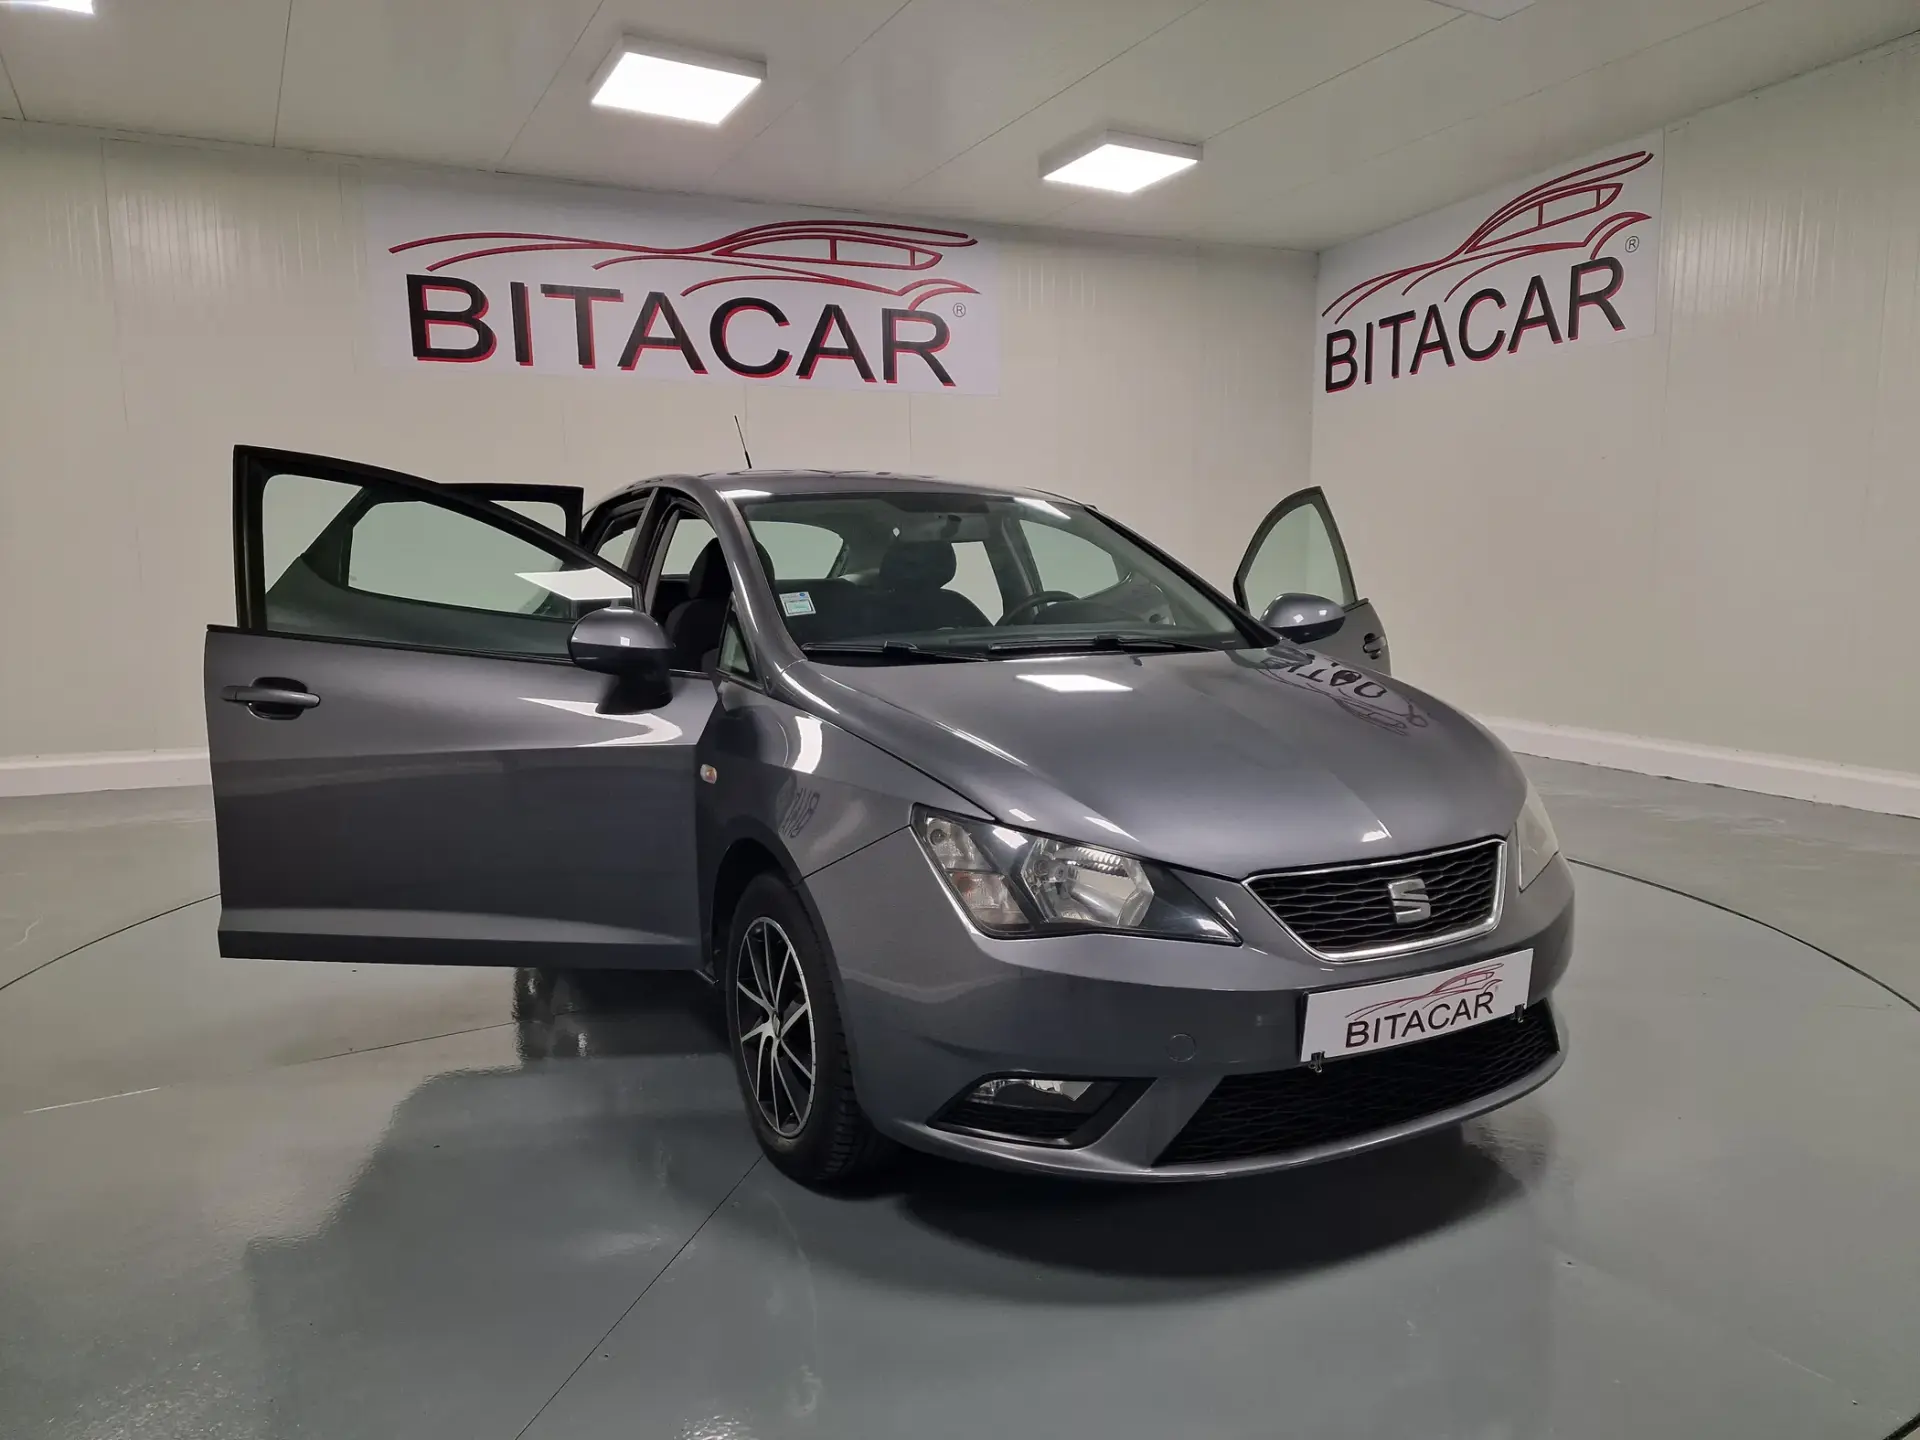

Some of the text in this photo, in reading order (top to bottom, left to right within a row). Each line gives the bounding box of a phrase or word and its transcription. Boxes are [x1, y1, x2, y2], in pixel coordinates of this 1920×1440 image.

[406, 274, 956, 387] BITACAR
[1325, 257, 1626, 393] BITACAR
[1346, 992, 1494, 1048] BITACAR
